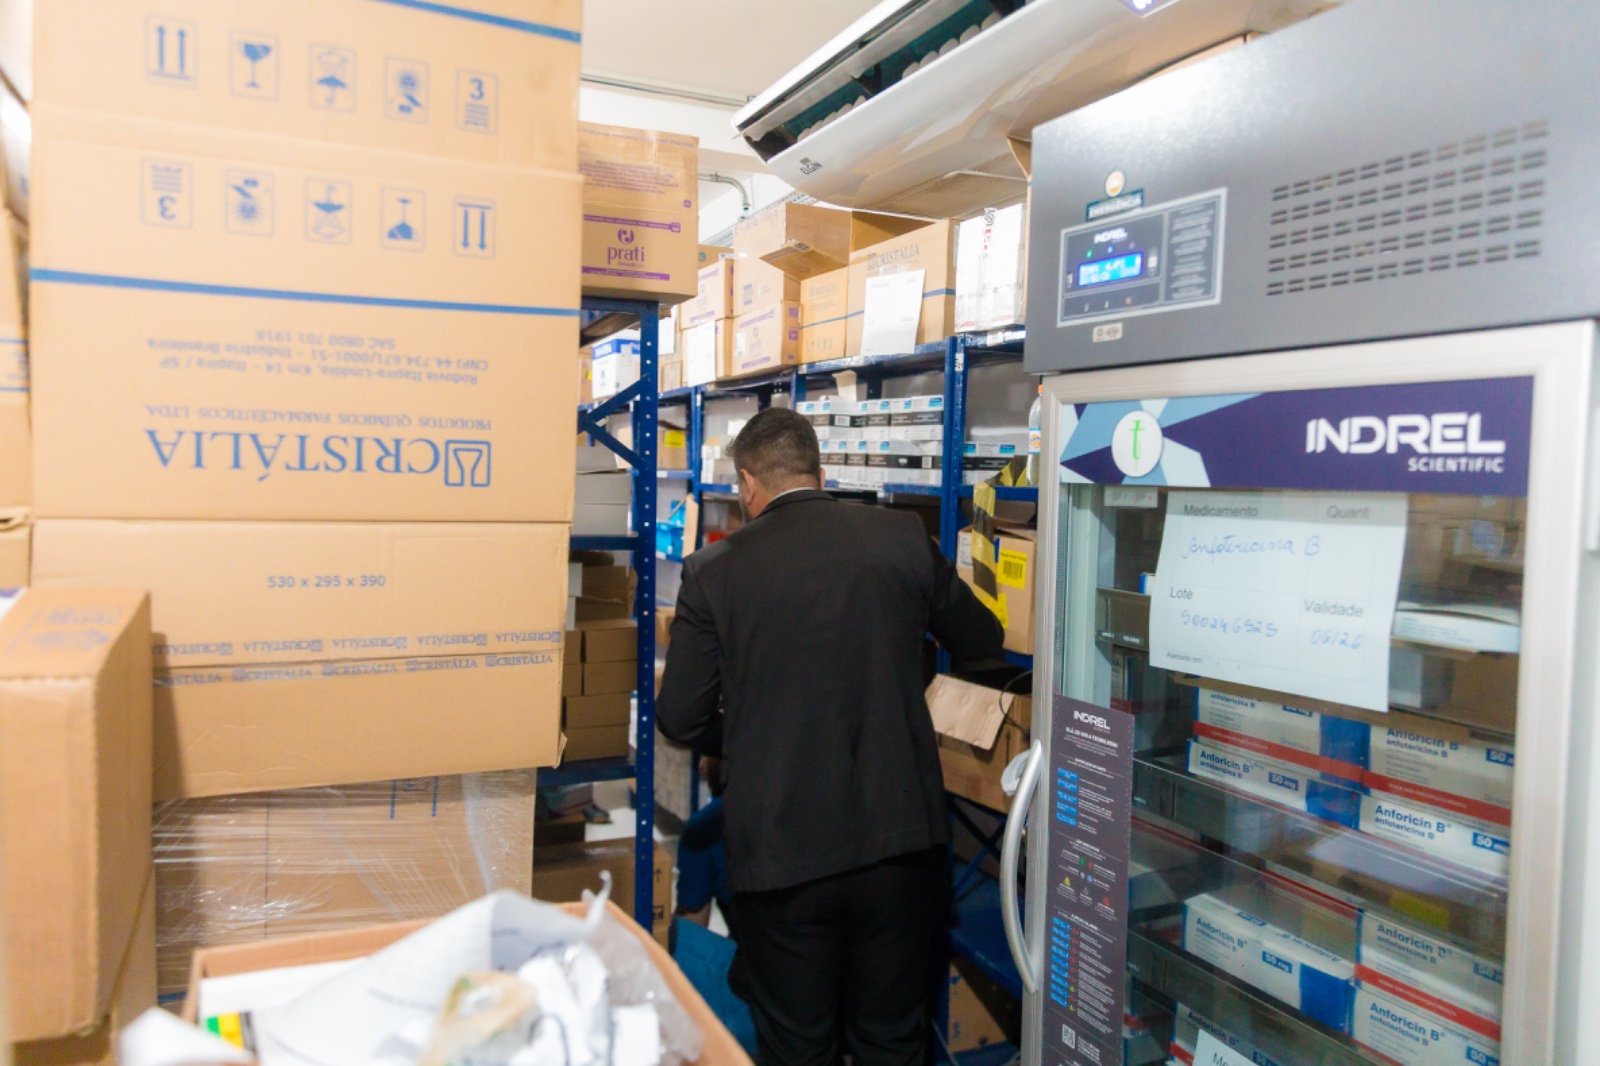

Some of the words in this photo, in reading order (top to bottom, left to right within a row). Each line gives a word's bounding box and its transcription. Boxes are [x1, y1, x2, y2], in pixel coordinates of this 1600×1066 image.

[470, 78, 485, 100] 3
[158, 196, 178, 220] 3
[607, 245, 645, 265] prati
[328, 335, 365, 348] 0800
[372, 338, 396, 350] SAC
[160, 357, 180, 370] SP
[196, 357, 247, 373] Itapira
[265, 362, 283, 374] 14
[288, 363, 312, 375] Km
[456, 358, 489, 371] CNPJ
[426, 371, 478, 386] Rodovia
[198, 407, 331, 426] FARMACÊUTICOS
[338, 411, 412, 428] QUÍMICOS
[418, 416, 492, 431] PRODUTOS
[1306, 411, 1506, 455] INDREL
[145, 429, 441, 482] CRISTÁLIA
[1407, 456, 1505, 474] SCIENTIFIC
[1183, 504, 1258, 518] Medicamento
[1326, 505, 1370, 519] Quant
[1304, 535, 1321, 556] B
[267, 575, 296, 589] 530
[314, 575, 342, 588] 295
[359, 574, 387, 588] 390
[1169, 586, 1194, 601] Lote
[1303, 599, 1365, 618] Validade
[243, 639, 312, 653] CRISTÁLIA
[333, 637, 399, 651] CRISTÁLIA
[417, 635, 477, 649] CRISTÁLIA
[495, 630, 552, 645] CRISTÁLIA
[245, 666, 313, 681] CRISTÁLIA
[334, 663, 398, 677] CRISTÁLIA
[417, 657, 478, 671] CRISTÁLIA
[496, 652, 553, 667] CRISTÁLIA
[1073, 710, 1111, 731] INDREL
[1386, 738, 1439, 757] anfotericina
[1200, 750, 1241, 770] Anforicin
[1271, 773, 1284, 784] 50
[1374, 804, 1432, 830] Anforicin
[1374, 816, 1426, 838] anfotericina
[1427, 831, 1435, 840] B
[1475, 834, 1494, 848] 50
[1376, 923, 1435, 954] Anforicin
[1264, 952, 1278, 965] 50
[1369, 1002, 1427, 1036] Anforicin
[1369, 1013, 1420, 1044] anfotericina
[1422, 1037, 1430, 1047] B
